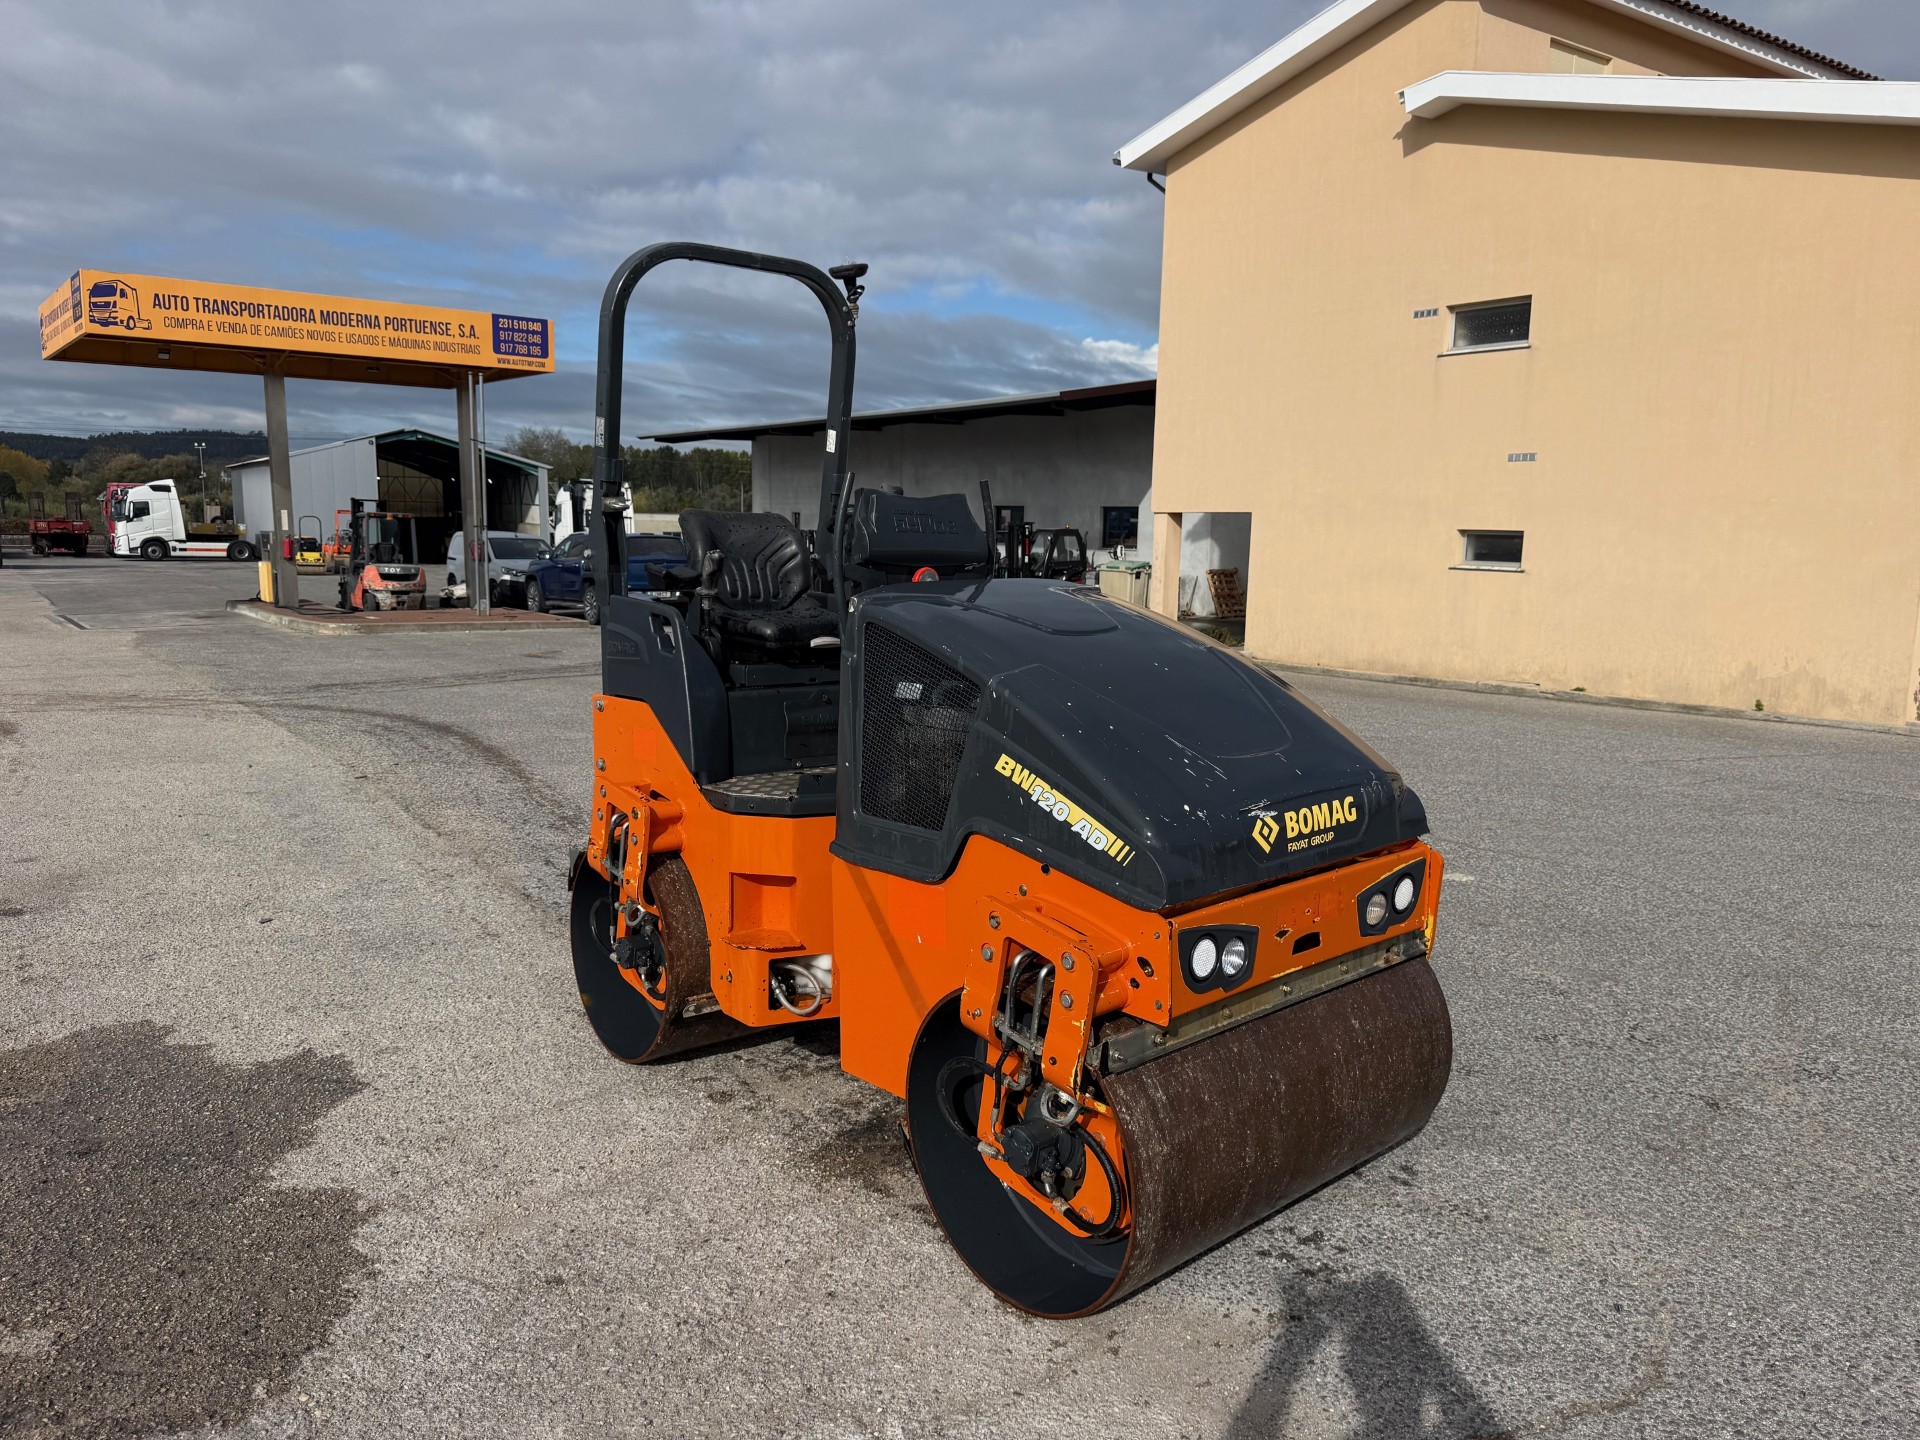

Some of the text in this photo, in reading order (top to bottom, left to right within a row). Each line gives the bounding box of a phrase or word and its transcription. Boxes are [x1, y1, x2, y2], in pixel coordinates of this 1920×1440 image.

[152, 293, 480, 340] AUTO TRANSPORTADORA MODERNA PORTUENSE, S.A.
[498, 318, 542, 332] 231 510 840
[163, 316, 481, 355] COMPRA E VENDA DE CAMIÕES NOVOS E USADOS E MÁQUINAS INDUSTRIAIS
[499, 330, 542, 344] 917 822 846
[500, 342, 542, 356] 917 768 195
[994, 753, 1109, 851] BW 120 AD
[1284, 795, 1357, 839] BOMAG
[1287, 831, 1335, 853] FAYAT GROUP
